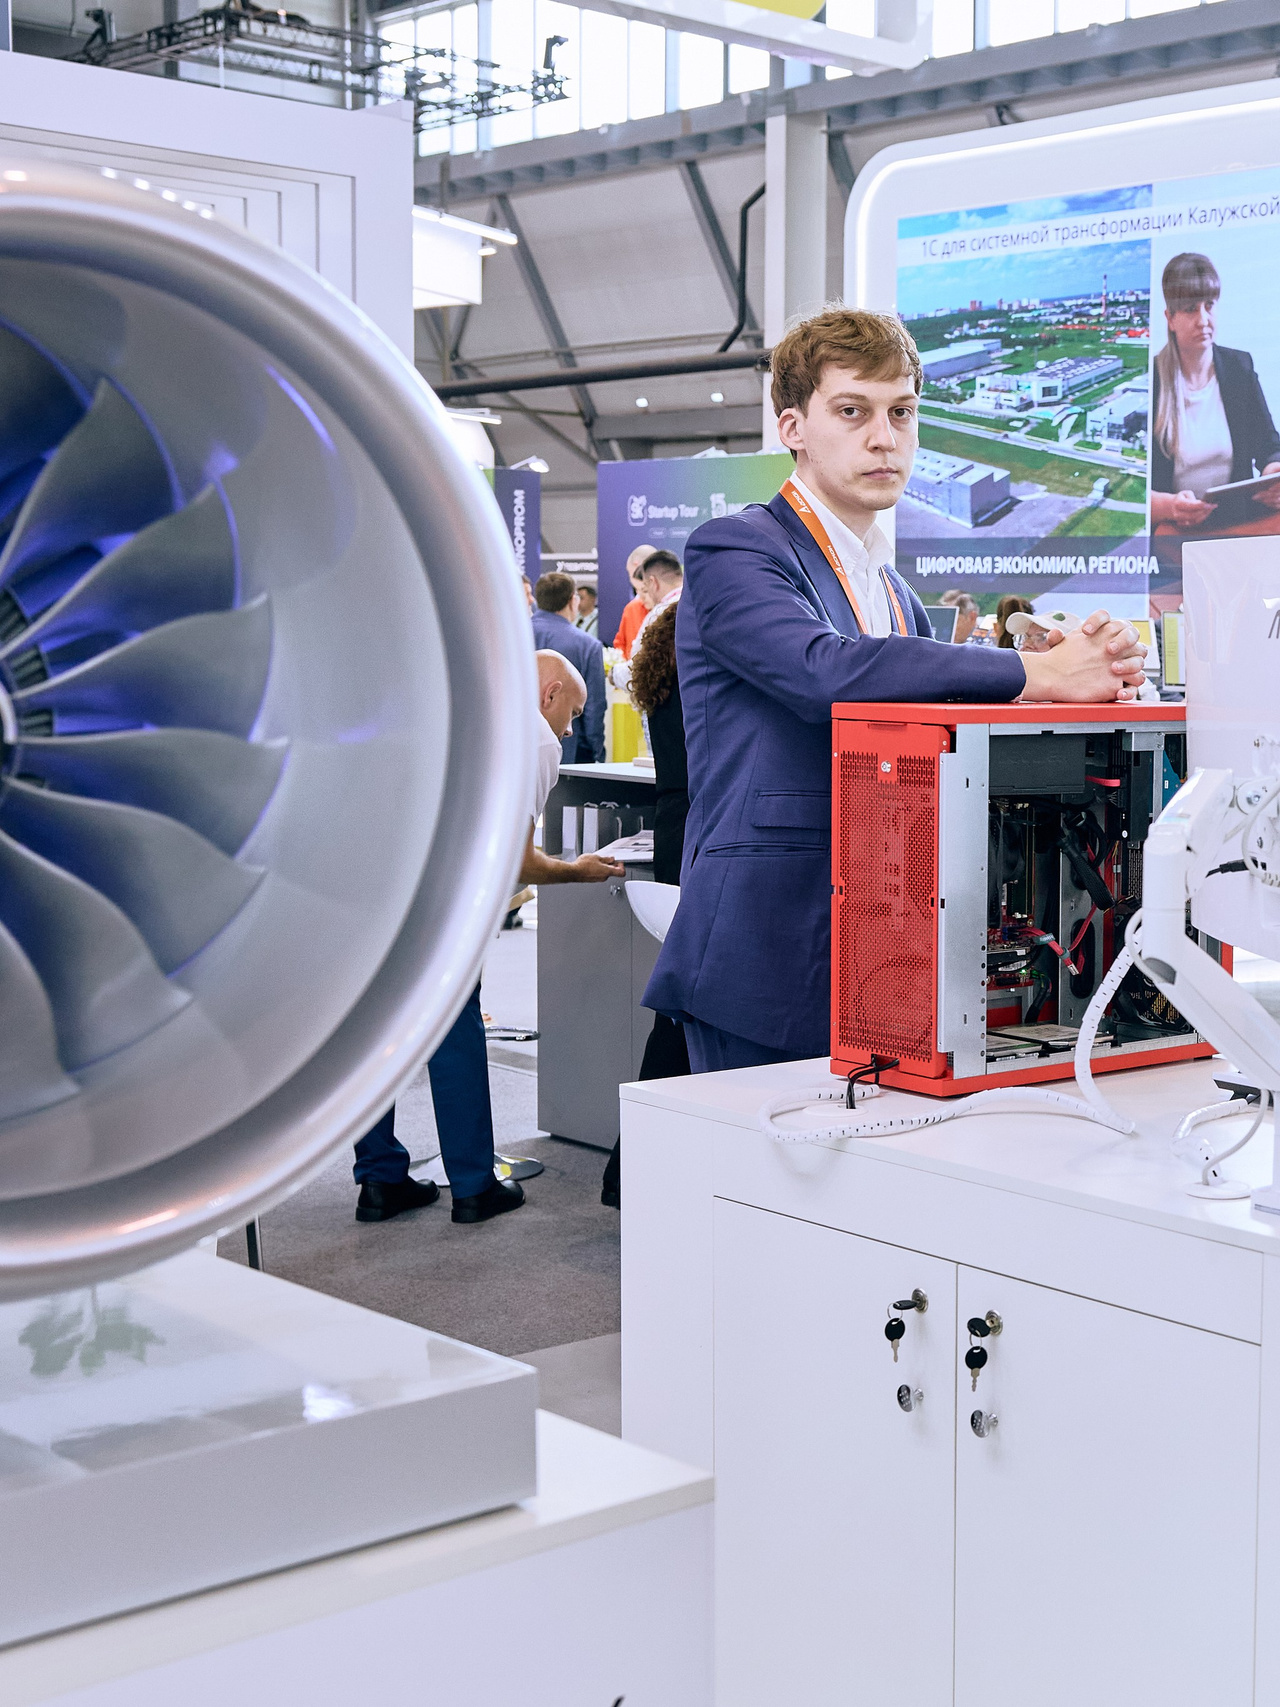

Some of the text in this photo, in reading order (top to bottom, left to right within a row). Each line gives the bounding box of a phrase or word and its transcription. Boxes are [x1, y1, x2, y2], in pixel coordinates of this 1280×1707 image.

[922, 239, 938, 257] 1С
[941, 240, 966, 259] для
[970, 224, 1050, 252] системной
[1054, 213, 1183, 246] трансформации
[1188, 195, 1280, 228] Калужской
[513, 489, 526, 576] NNOPROM
[916, 555, 1160, 578] ЦИФРОВАЯ ЭКОНОМИКА РЕГИОНА
